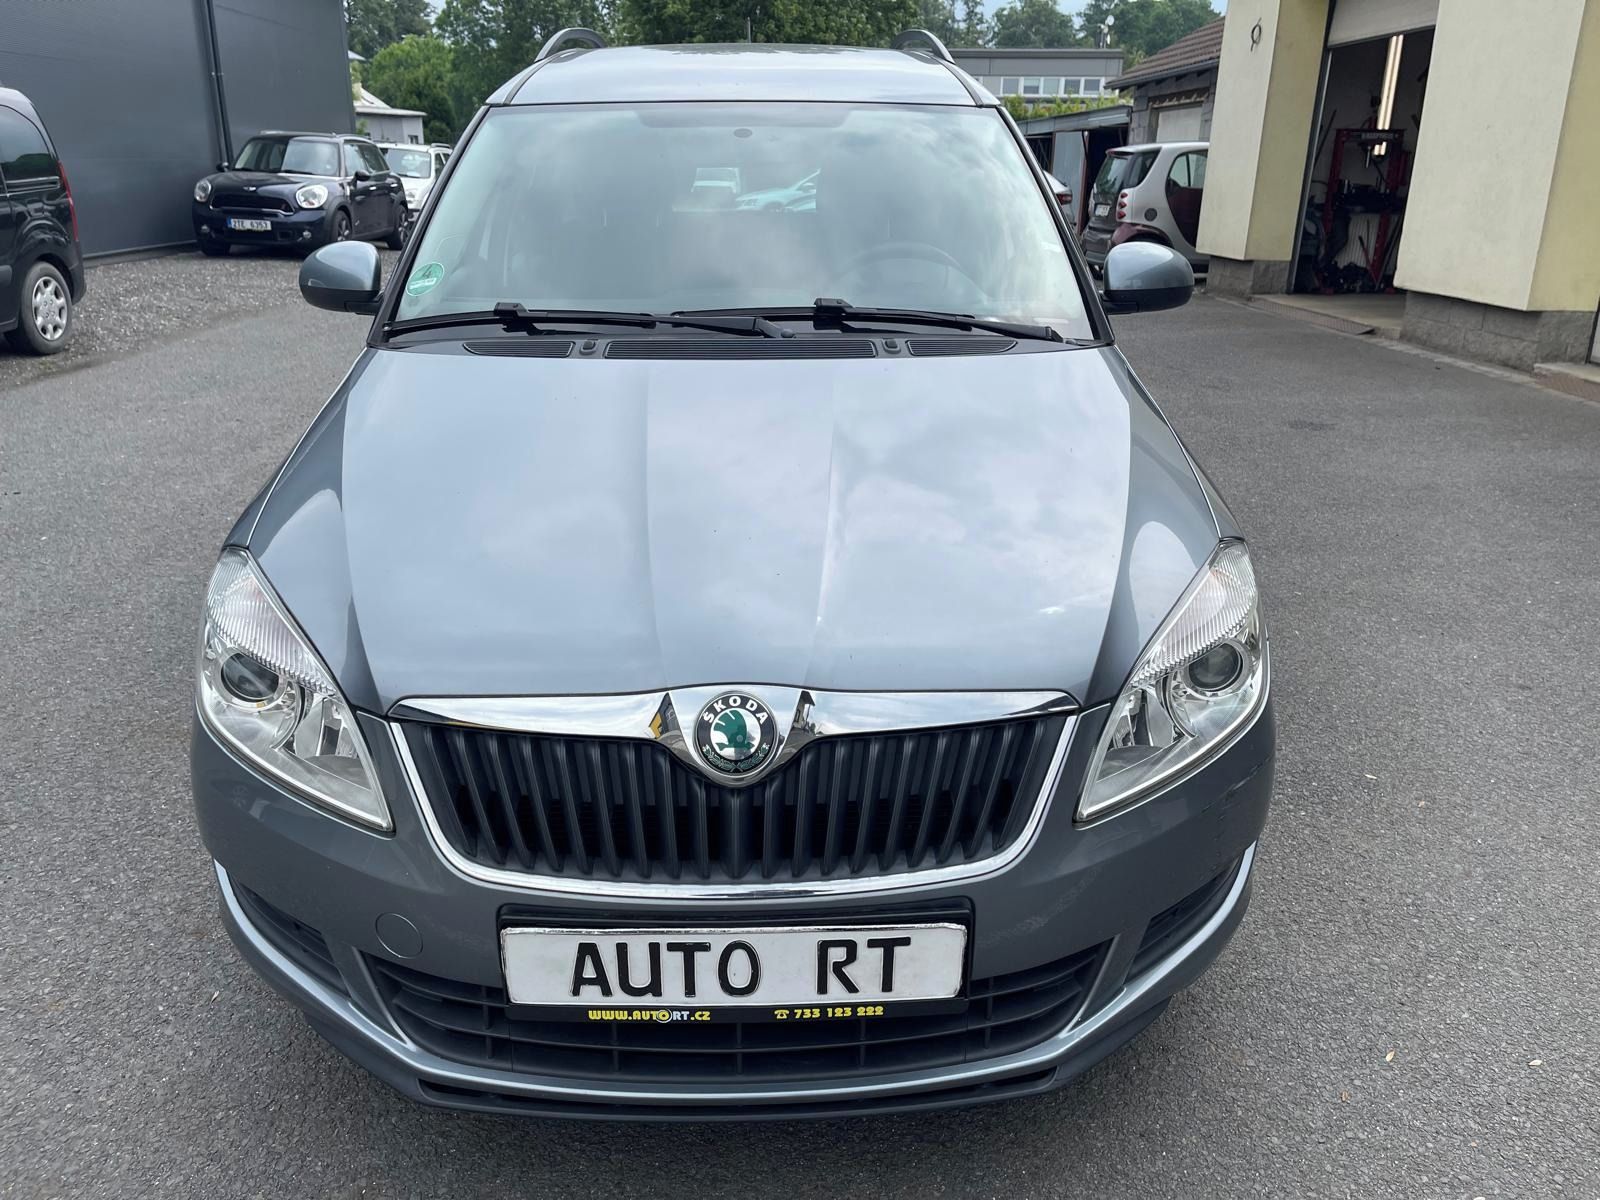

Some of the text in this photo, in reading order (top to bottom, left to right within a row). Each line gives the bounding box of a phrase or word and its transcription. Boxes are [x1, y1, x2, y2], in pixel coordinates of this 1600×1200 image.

[571, 936, 912, 997] AUTO RT
[793, 1008, 821, 1019] 733
[826, 1007, 852, 1018] 123
[856, 1005, 884, 1017] 222
